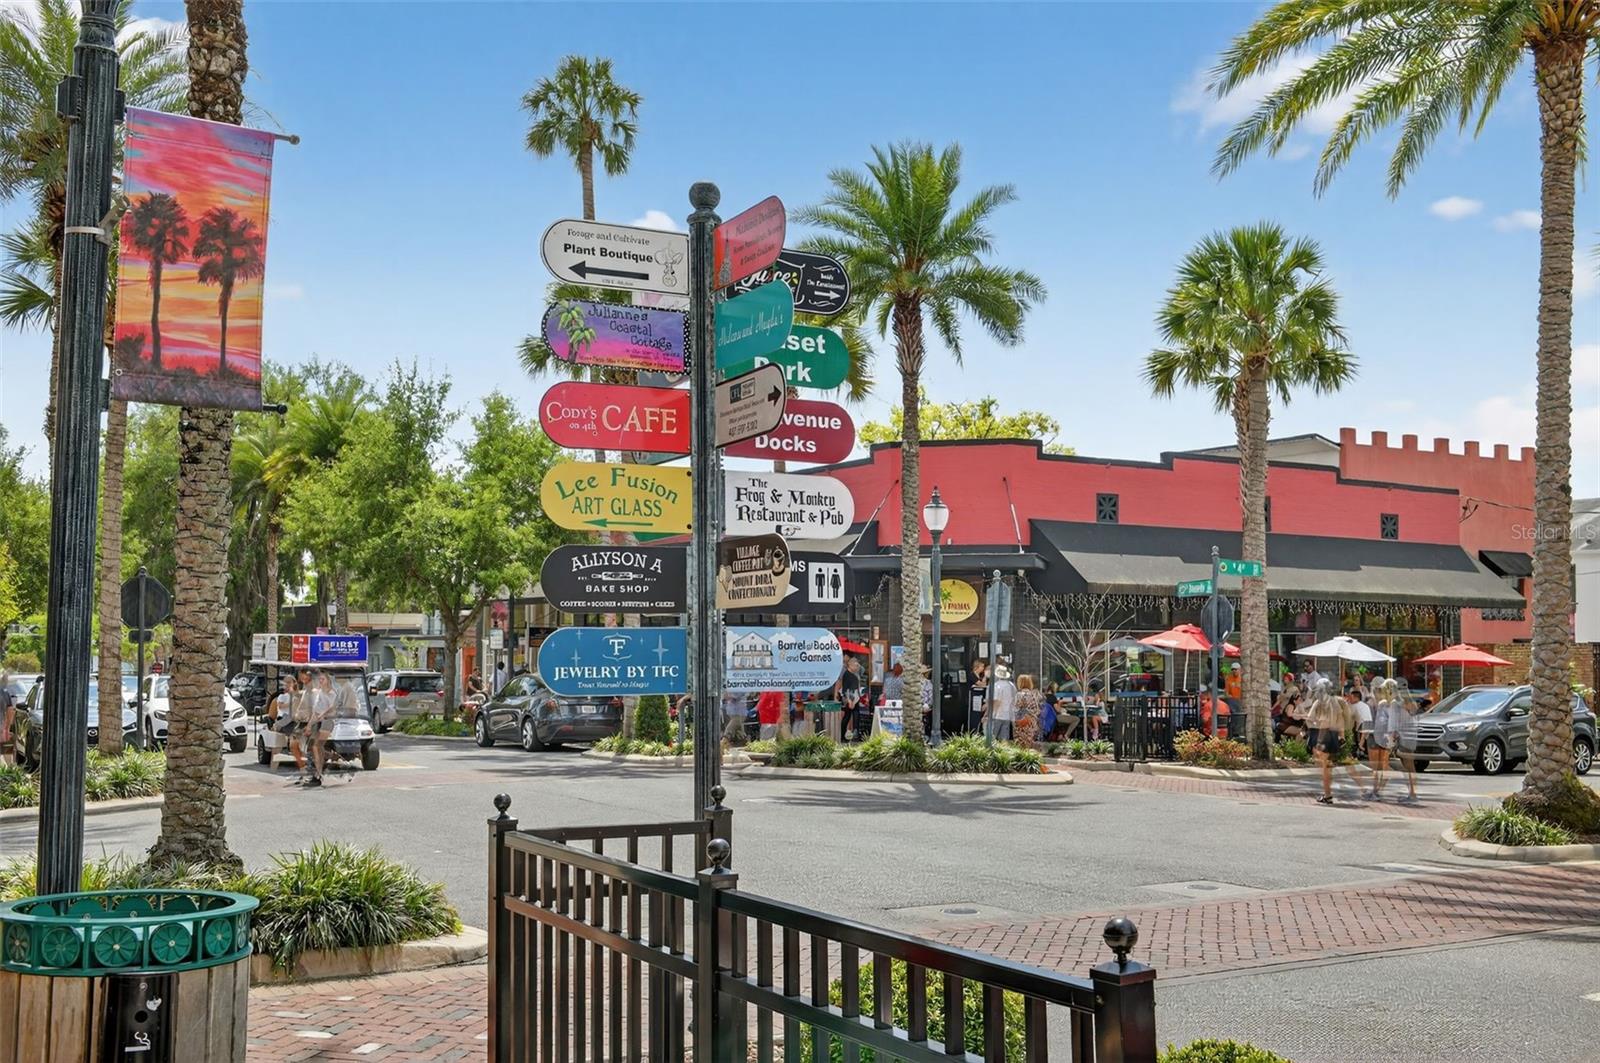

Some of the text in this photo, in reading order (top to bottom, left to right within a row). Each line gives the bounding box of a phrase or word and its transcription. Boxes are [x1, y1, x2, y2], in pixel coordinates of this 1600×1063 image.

[567, 228, 650, 246] Forage and Cultivate
[563, 243, 653, 264] Plant Boutique
[610, 320, 652, 337] Coastal
[631, 336, 673, 352] Cottage
[781, 334, 826, 354] set
[754, 356, 812, 383] Prk
[569, 420, 597, 432] on 4th
[601, 404, 677, 434] CAFE
[780, 412, 842, 430] venue
[755, 434, 817, 453] Docks
[555, 467, 678, 504] Lee Fusion
[748, 477, 768, 489] The
[571, 496, 663, 518] ART GLASS
[735, 486, 836, 511] Frog & Monkey
[735, 504, 844, 528] Restaurant & Pub
[571, 551, 663, 574] ALLYSON A
[585, 584, 650, 593] BAKE SHOP
[777, 640, 806, 650] Barrel
[813, 640, 840, 650] Books
[799, 651, 832, 663] Games
[553, 665, 680, 681] JEWELRY BY TFC
